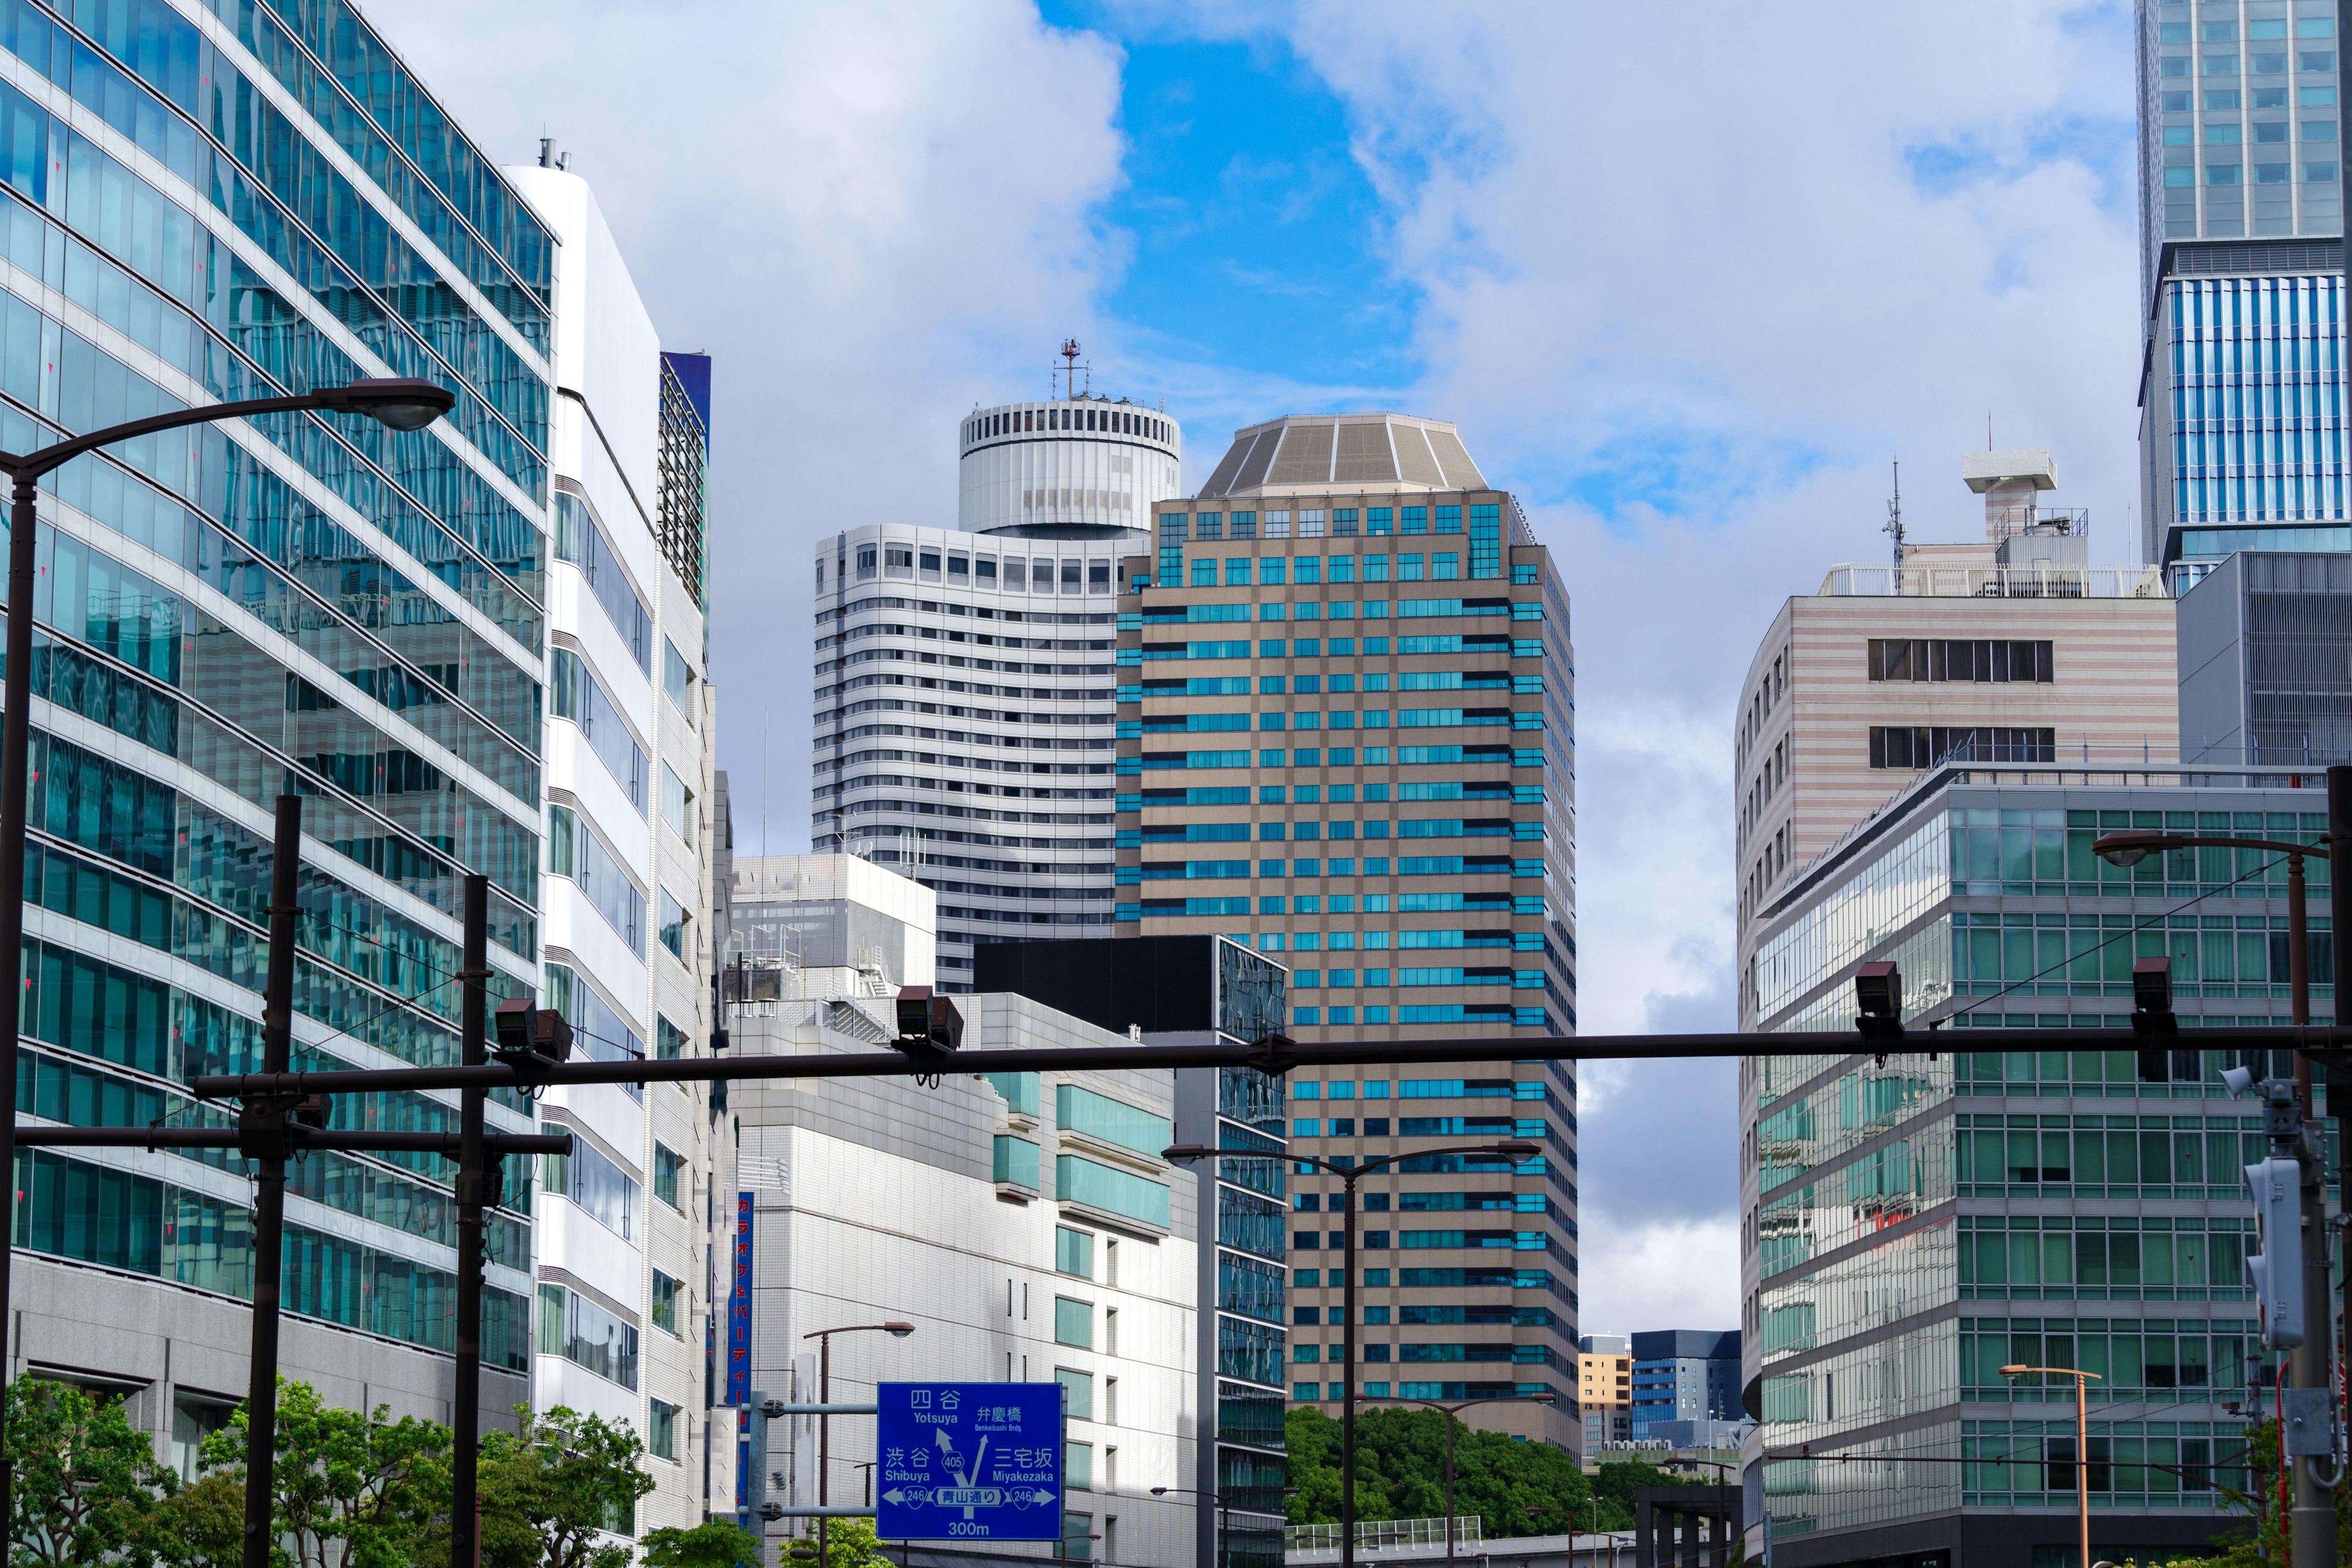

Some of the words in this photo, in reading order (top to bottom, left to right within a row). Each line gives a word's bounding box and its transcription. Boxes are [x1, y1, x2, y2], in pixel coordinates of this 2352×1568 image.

[911, 1390, 960, 1409] 四谷
[914, 1412, 957, 1425] Yotsuya
[977, 1406, 1021, 1422] 弁慶橋
[886, 1447, 929, 1468] 渋谷
[944, 1456, 962, 1468] 405
[994, 1448, 1053, 1468] 三宅坂
[885, 1470, 930, 1483] Shibuya
[993, 1471, 1054, 1483] Miyakezaka
[907, 1490, 924, 1501] 246
[942, 1490, 995, 1503] 青山通り
[1014, 1491, 1031, 1501] 246
[948, 1522, 989, 1536] 300m
